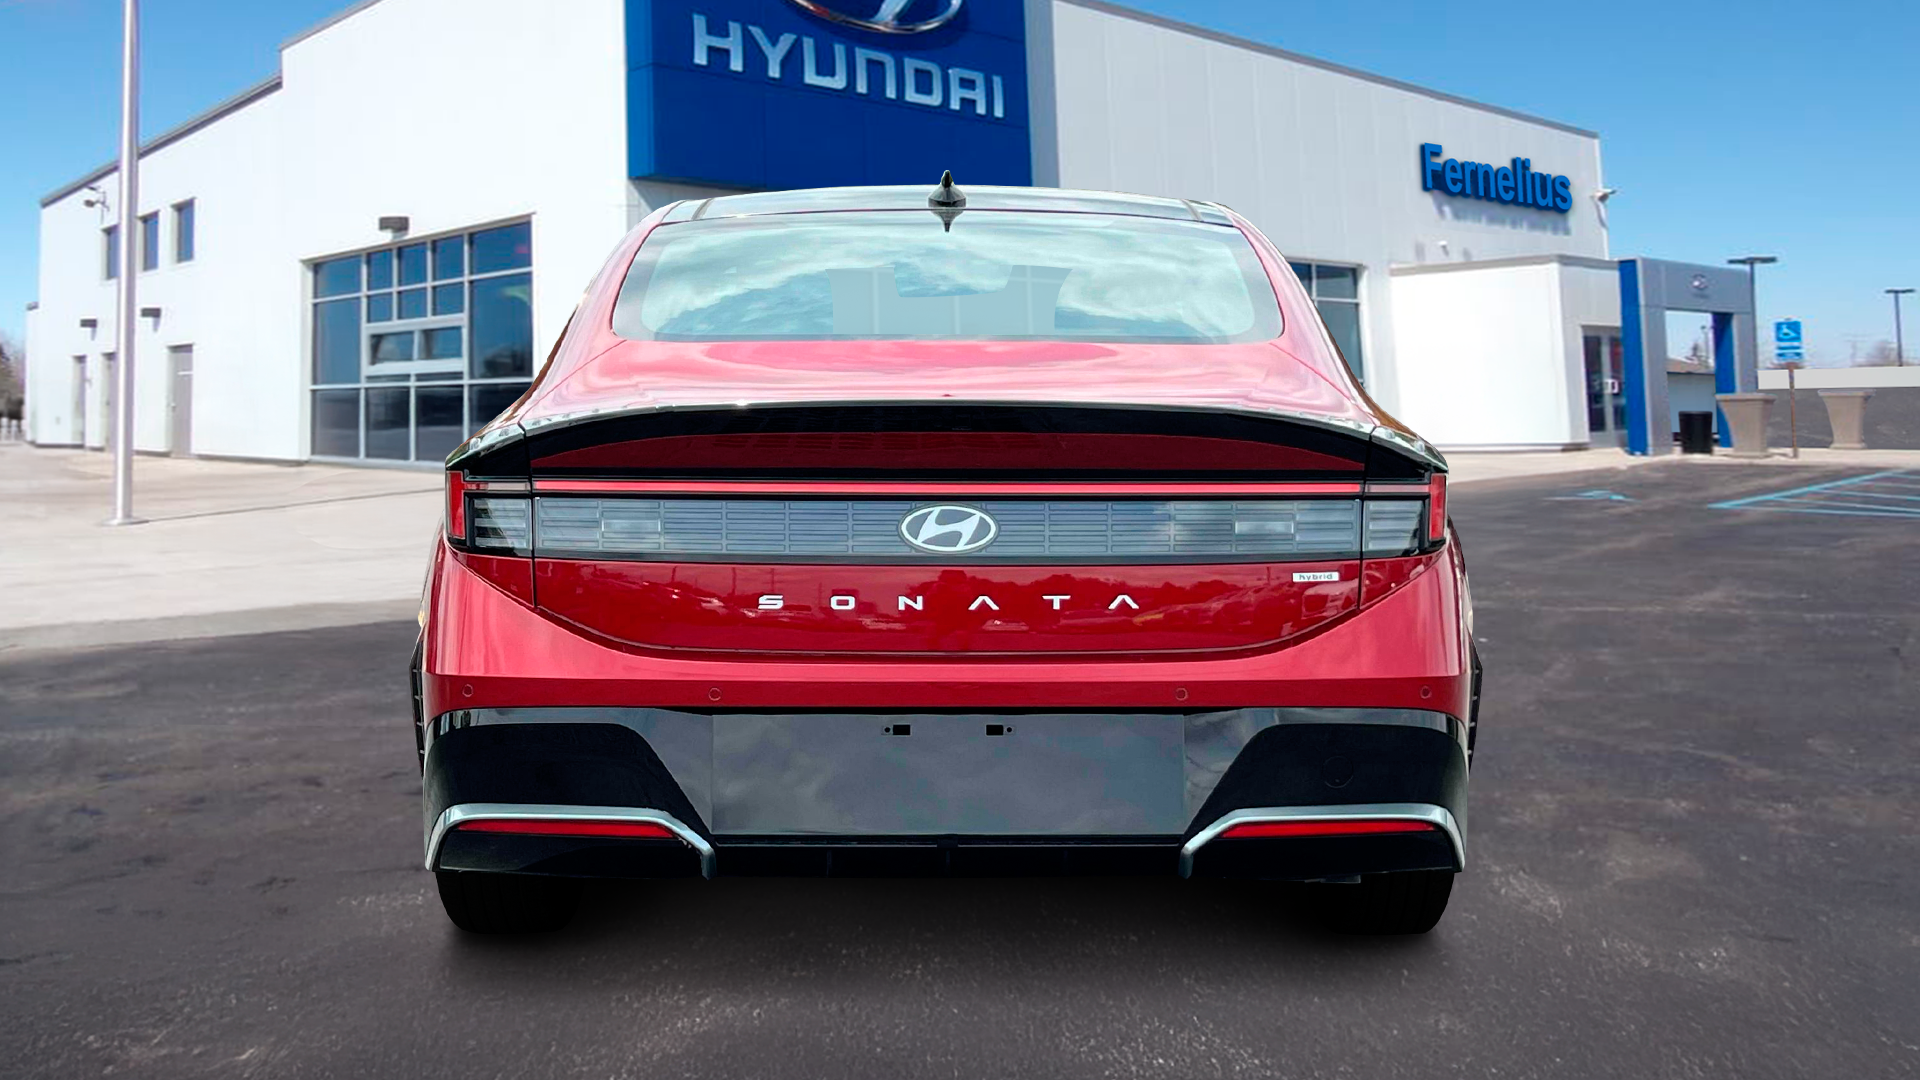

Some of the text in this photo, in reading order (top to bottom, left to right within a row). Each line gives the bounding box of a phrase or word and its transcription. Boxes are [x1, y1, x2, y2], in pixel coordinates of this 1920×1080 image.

[692, 14, 1004, 118] HYUNDAI
[1420, 142, 1573, 213] Fernelius
[1298, 573, 1333, 581] hybrid
[757, 594, 1139, 610] SONATA
